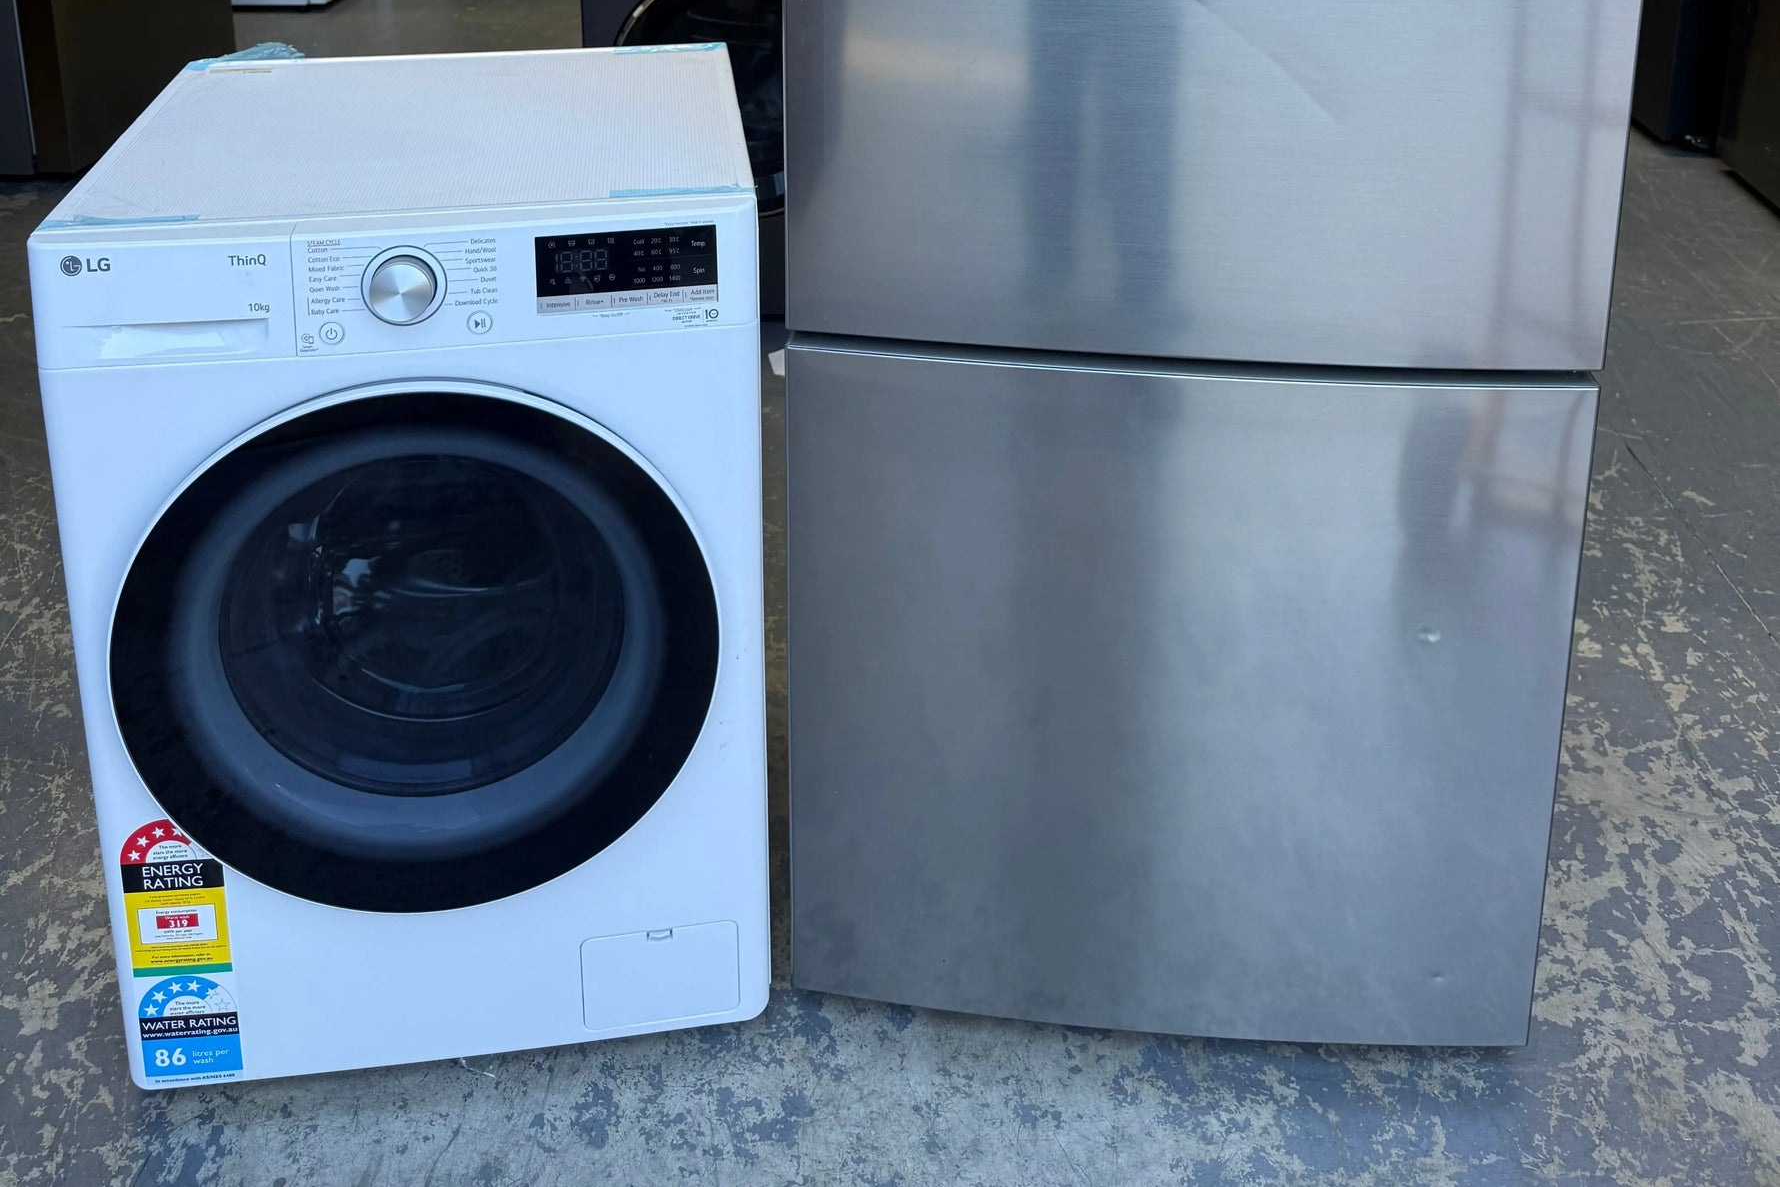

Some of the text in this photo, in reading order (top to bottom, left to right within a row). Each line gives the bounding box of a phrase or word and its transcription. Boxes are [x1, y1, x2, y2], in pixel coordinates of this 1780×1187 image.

[86, 258, 111, 272] LG
[228, 254, 266, 266] ThinQ
[248, 303, 270, 313] 10kg
[705, 309, 719, 319] 10
[142, 863, 203, 878] ENERGY
[144, 876, 203, 890] RATING
[169, 920, 188, 928] 319
[142, 1016, 236, 1031] WATER RATING
[142, 1027, 238, 1038] www.waterrating.gov.au
[155, 1048, 186, 1067] 86
